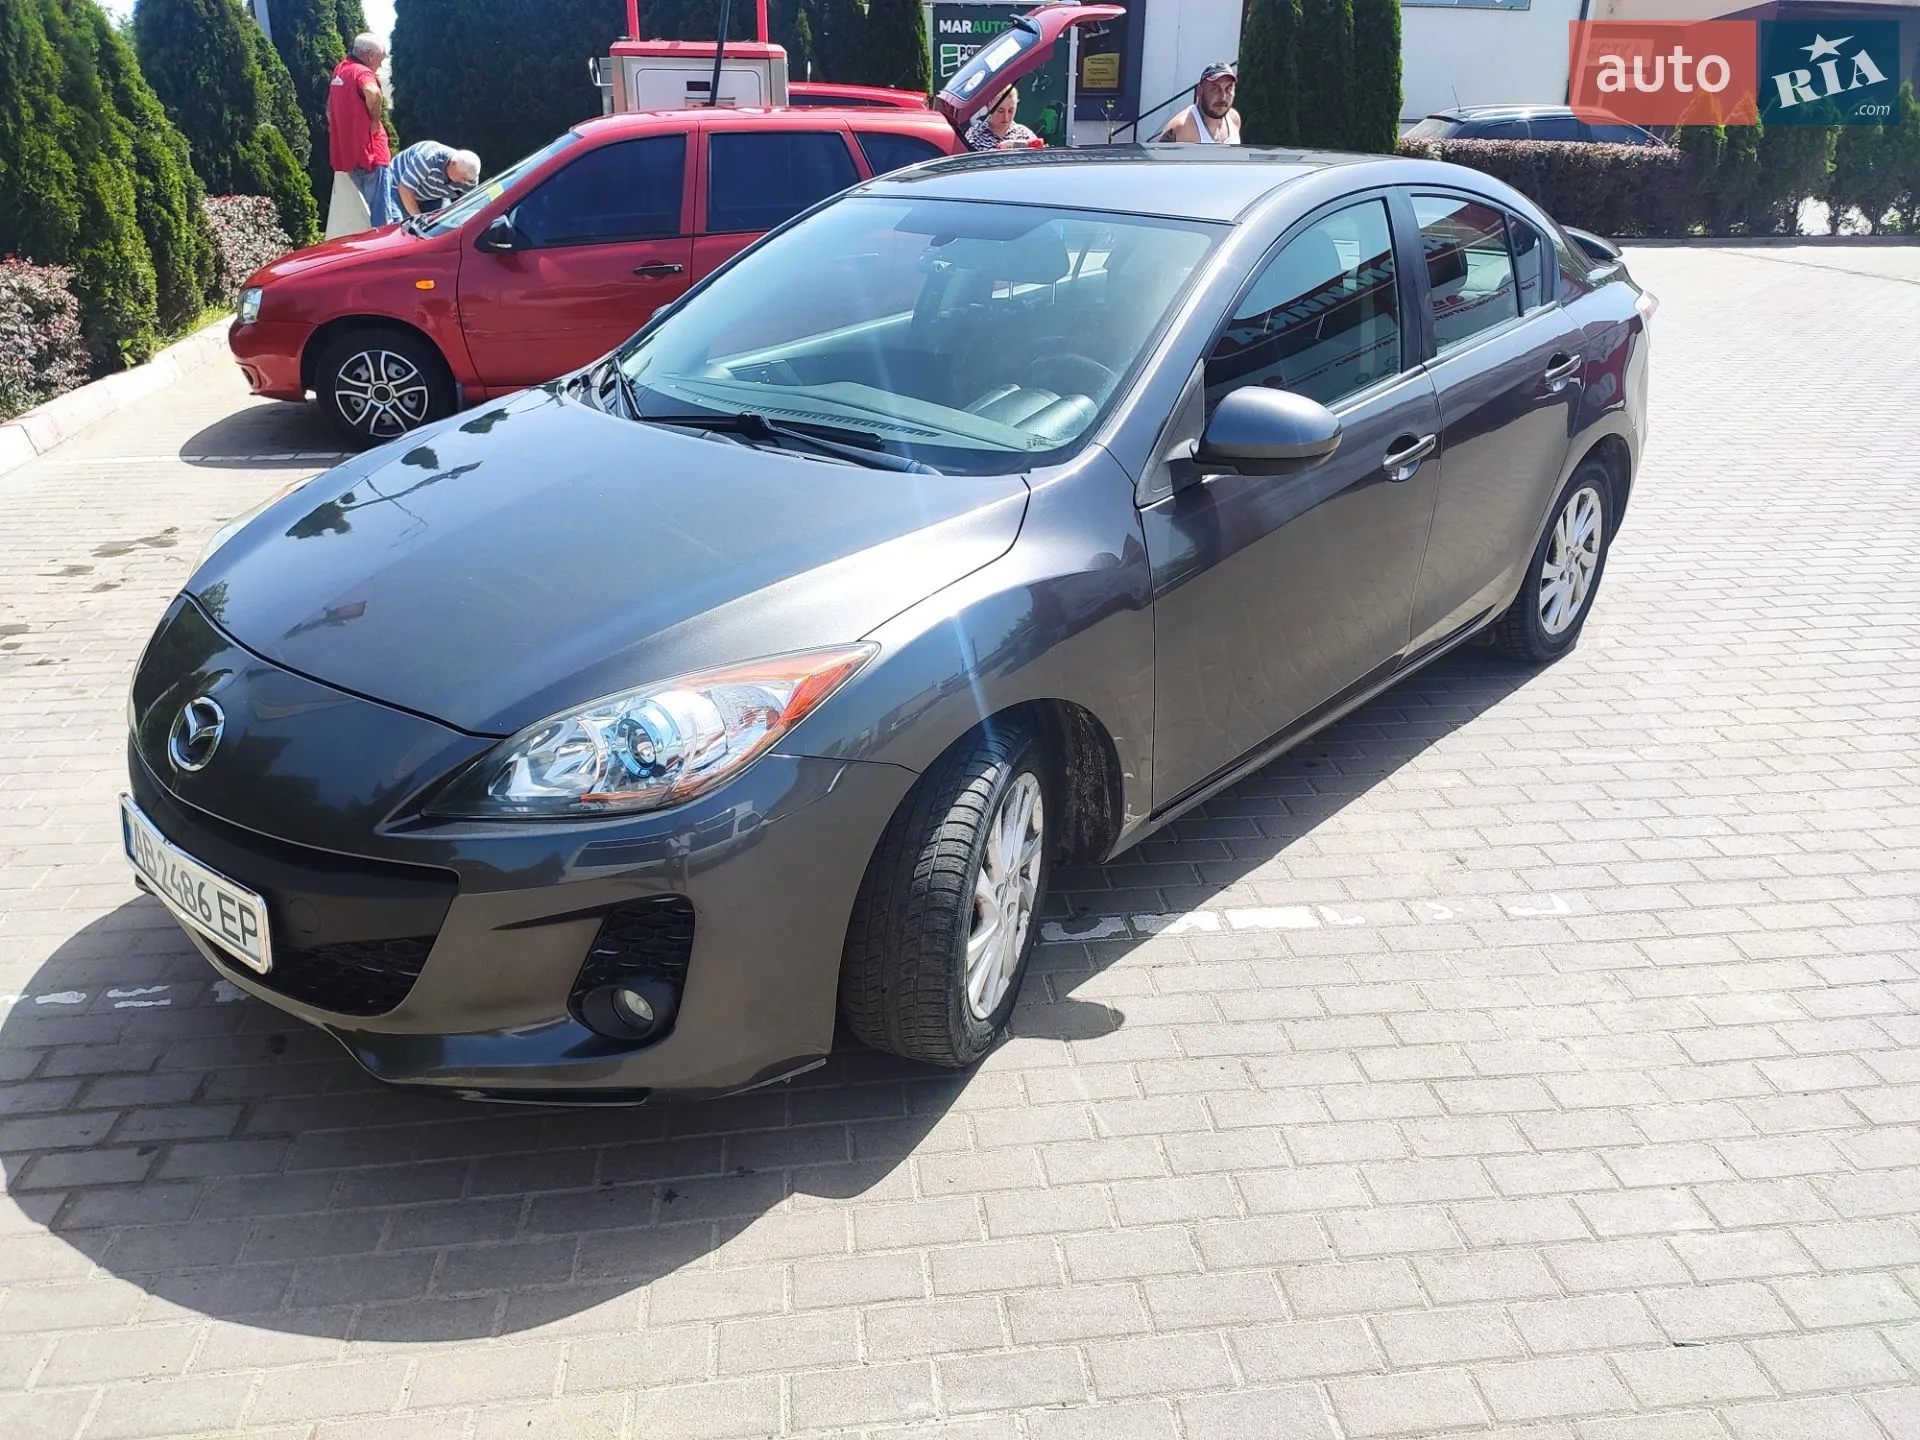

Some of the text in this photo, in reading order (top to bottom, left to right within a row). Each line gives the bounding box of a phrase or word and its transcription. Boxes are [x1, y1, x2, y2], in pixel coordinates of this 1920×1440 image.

[134, 823, 257, 946] AB 2486 EP
